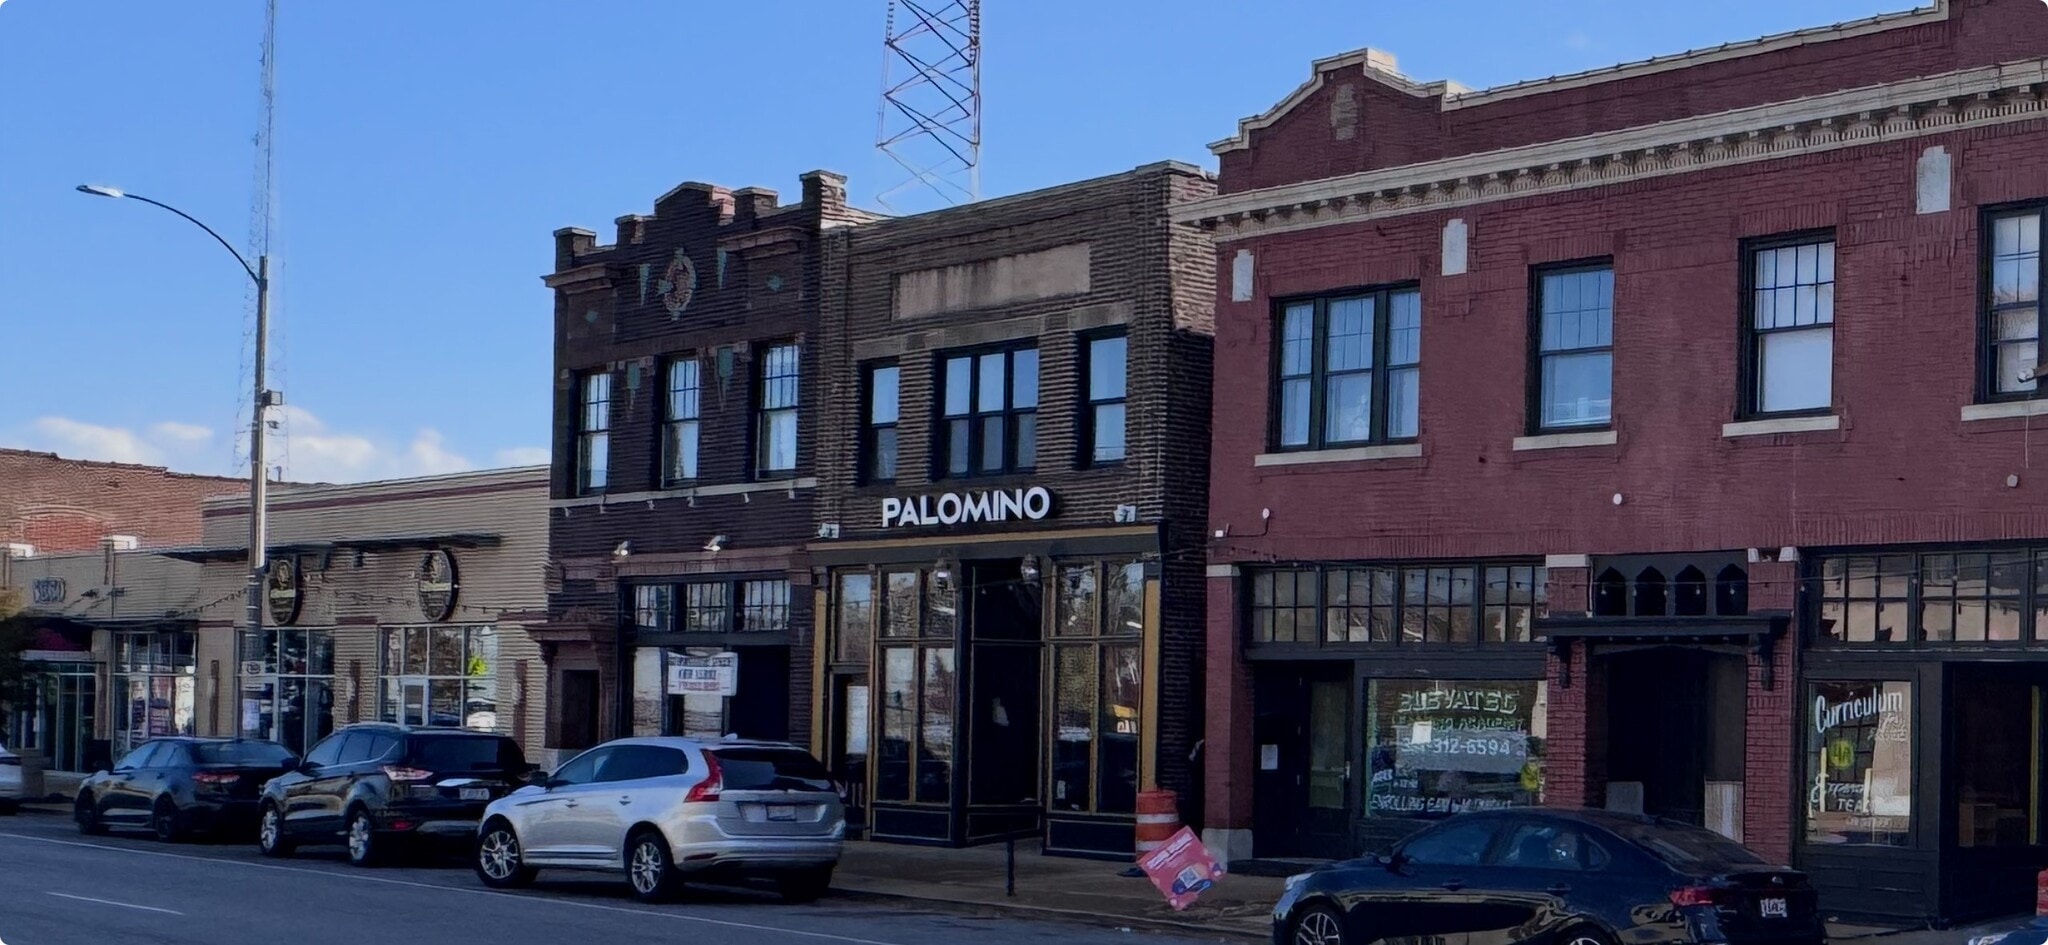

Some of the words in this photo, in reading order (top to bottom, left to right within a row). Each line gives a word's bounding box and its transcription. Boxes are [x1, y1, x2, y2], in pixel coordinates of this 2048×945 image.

[881, 486, 1051, 527] PALOMINO
[1397, 688, 1520, 715] ELEVATED
[1815, 687, 1902, 733] Curriculum
